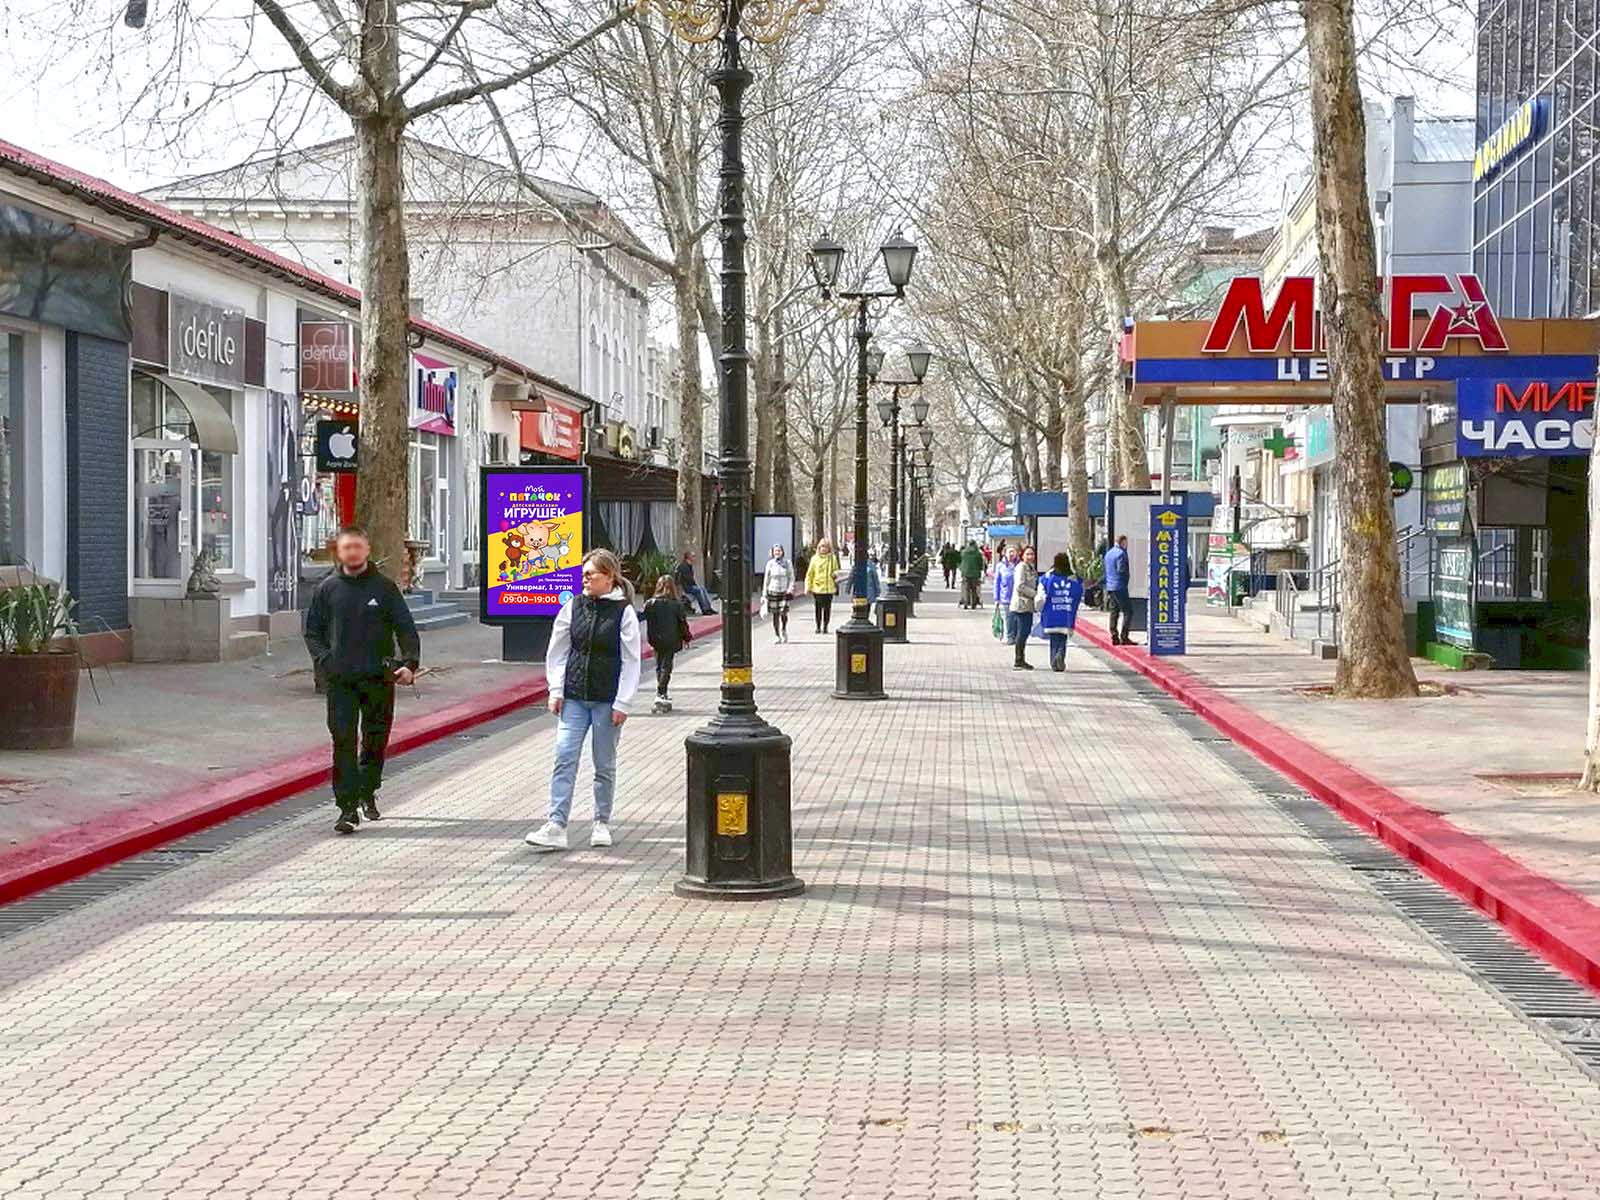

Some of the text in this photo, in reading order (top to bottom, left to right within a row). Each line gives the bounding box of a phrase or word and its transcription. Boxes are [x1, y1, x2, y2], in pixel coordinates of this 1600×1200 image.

[1201, 273, 1509, 353] МГА
[184, 316, 236, 366] defile
[303, 344, 347, 361] defile
[1276, 356, 1436, 381] ЦЕТР
[525, 485, 545, 493] Мой
[504, 507, 566, 518] ИГРУШЕК
[506, 583, 547, 591] Универмаг,
